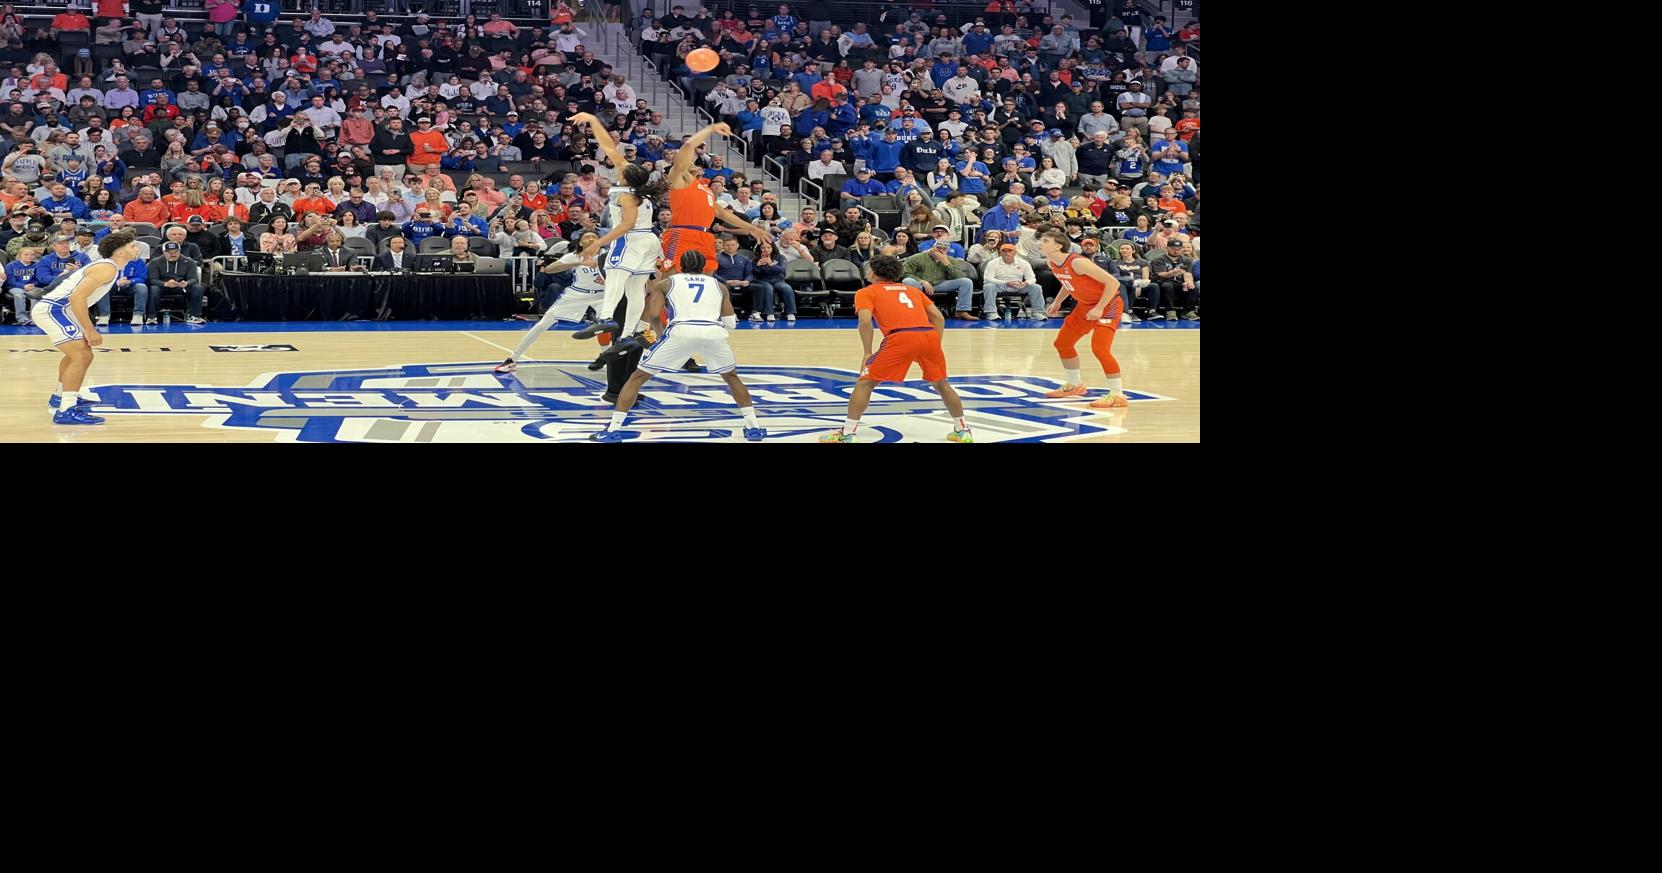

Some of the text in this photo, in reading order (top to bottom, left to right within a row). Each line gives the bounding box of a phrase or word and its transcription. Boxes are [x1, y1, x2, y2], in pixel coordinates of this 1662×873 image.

[916, 146, 938, 154] Duke
[1129, 161, 1137, 169] 2
[688, 283, 705, 303] 7
[897, 292, 913, 309] 4
